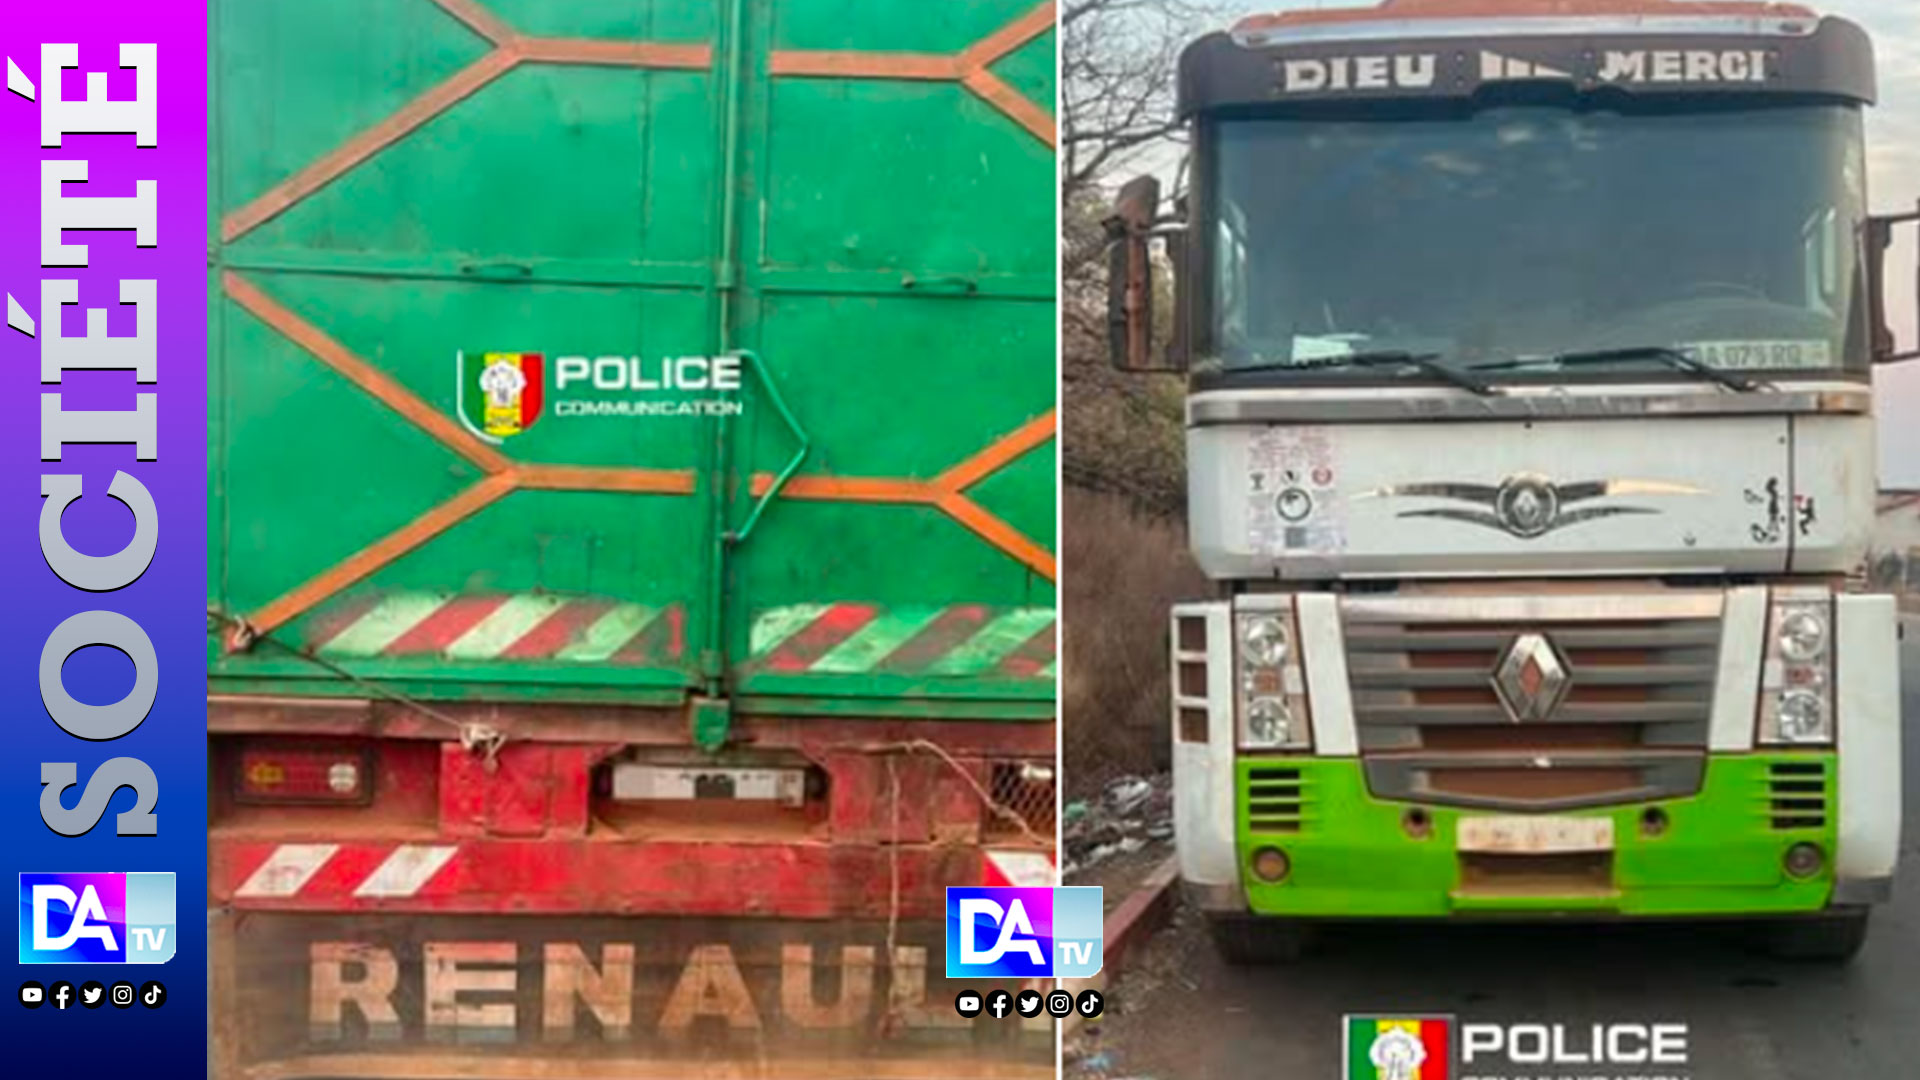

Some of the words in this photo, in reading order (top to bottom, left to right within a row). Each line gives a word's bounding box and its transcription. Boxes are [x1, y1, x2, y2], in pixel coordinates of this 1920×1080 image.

[1284, 54, 1436, 92] DIEU
[1599, 49, 1766, 83] MERCI
[307, 940, 1055, 1040] RENAUL
